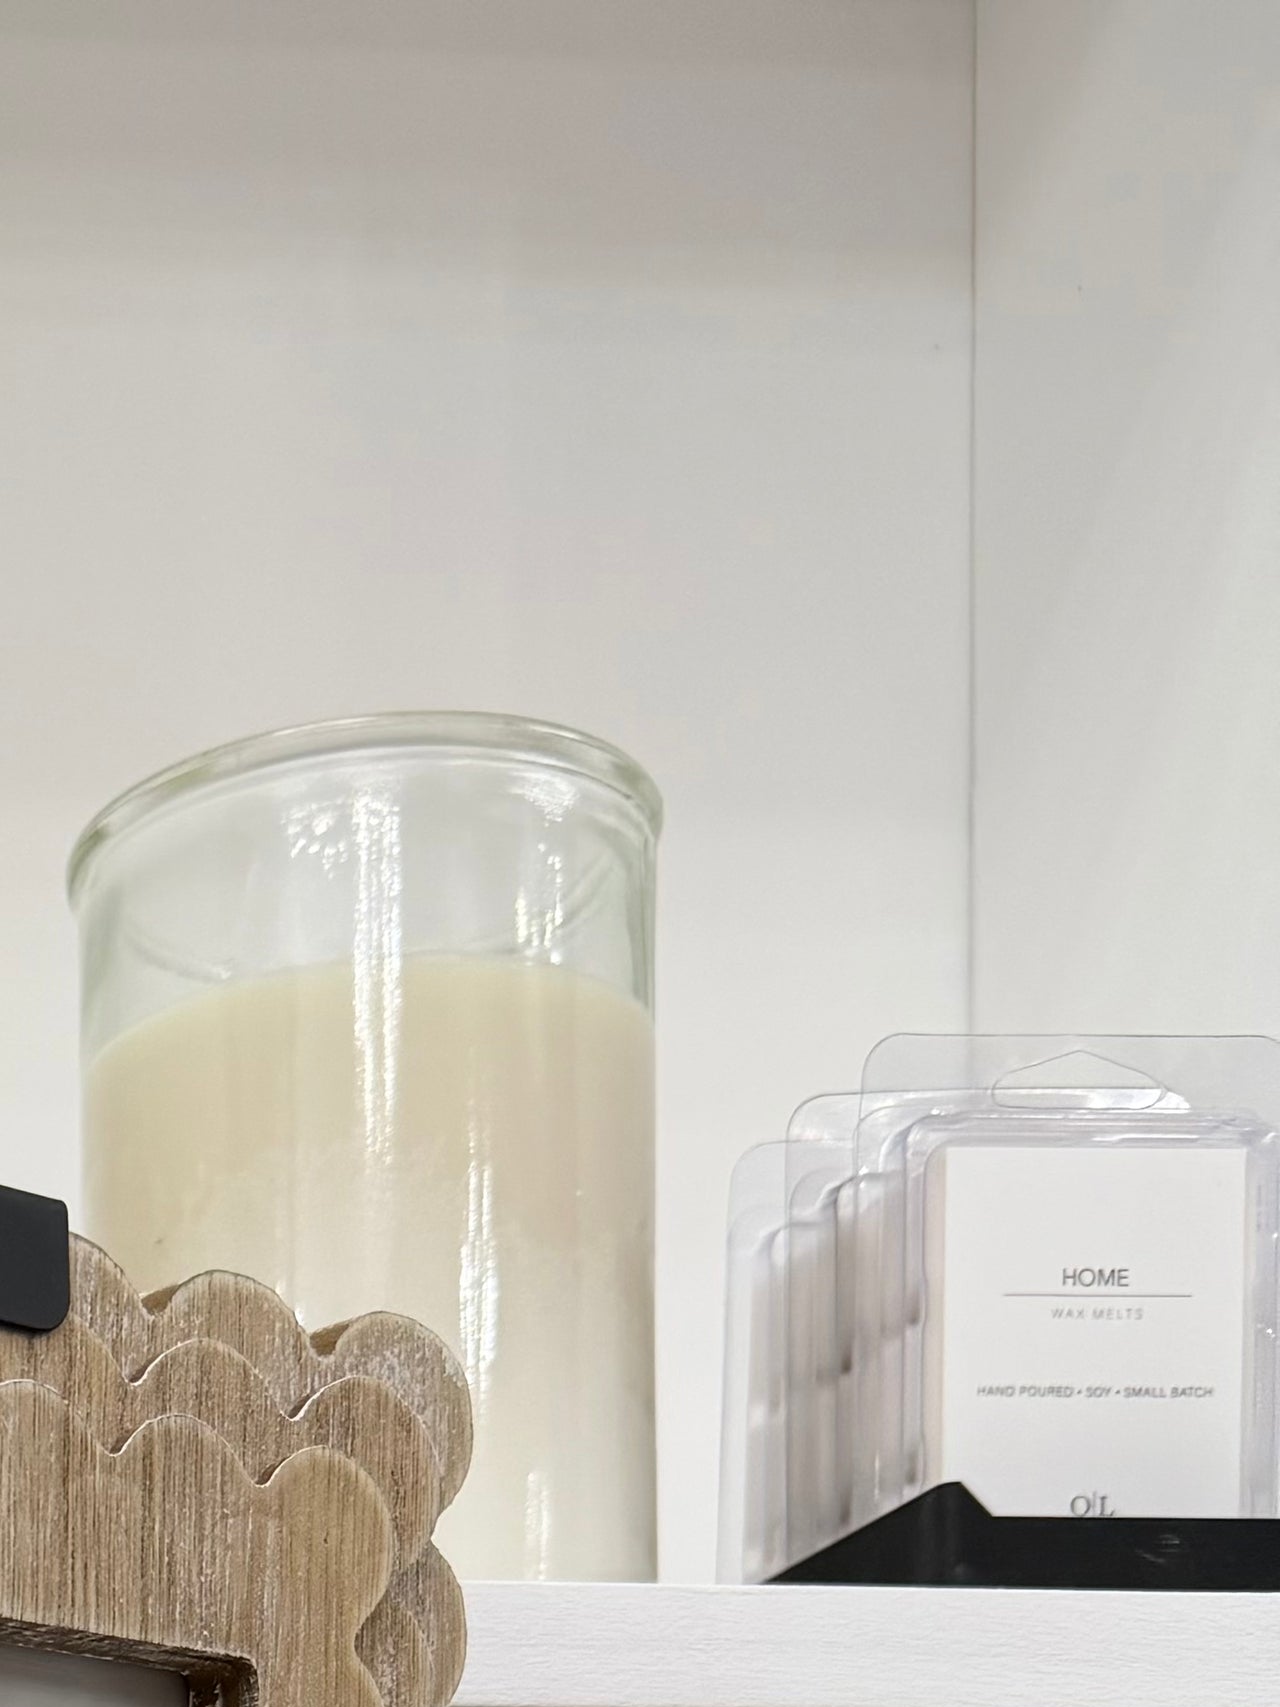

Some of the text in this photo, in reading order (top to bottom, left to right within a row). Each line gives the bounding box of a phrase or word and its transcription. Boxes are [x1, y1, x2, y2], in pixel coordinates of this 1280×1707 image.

[1061, 1268, 1130, 1288] HOME
[1050, 1308, 1144, 1321] WAX MELTS
[977, 1386, 1215, 1399] HAND POURED SOY SMALL BATCH
